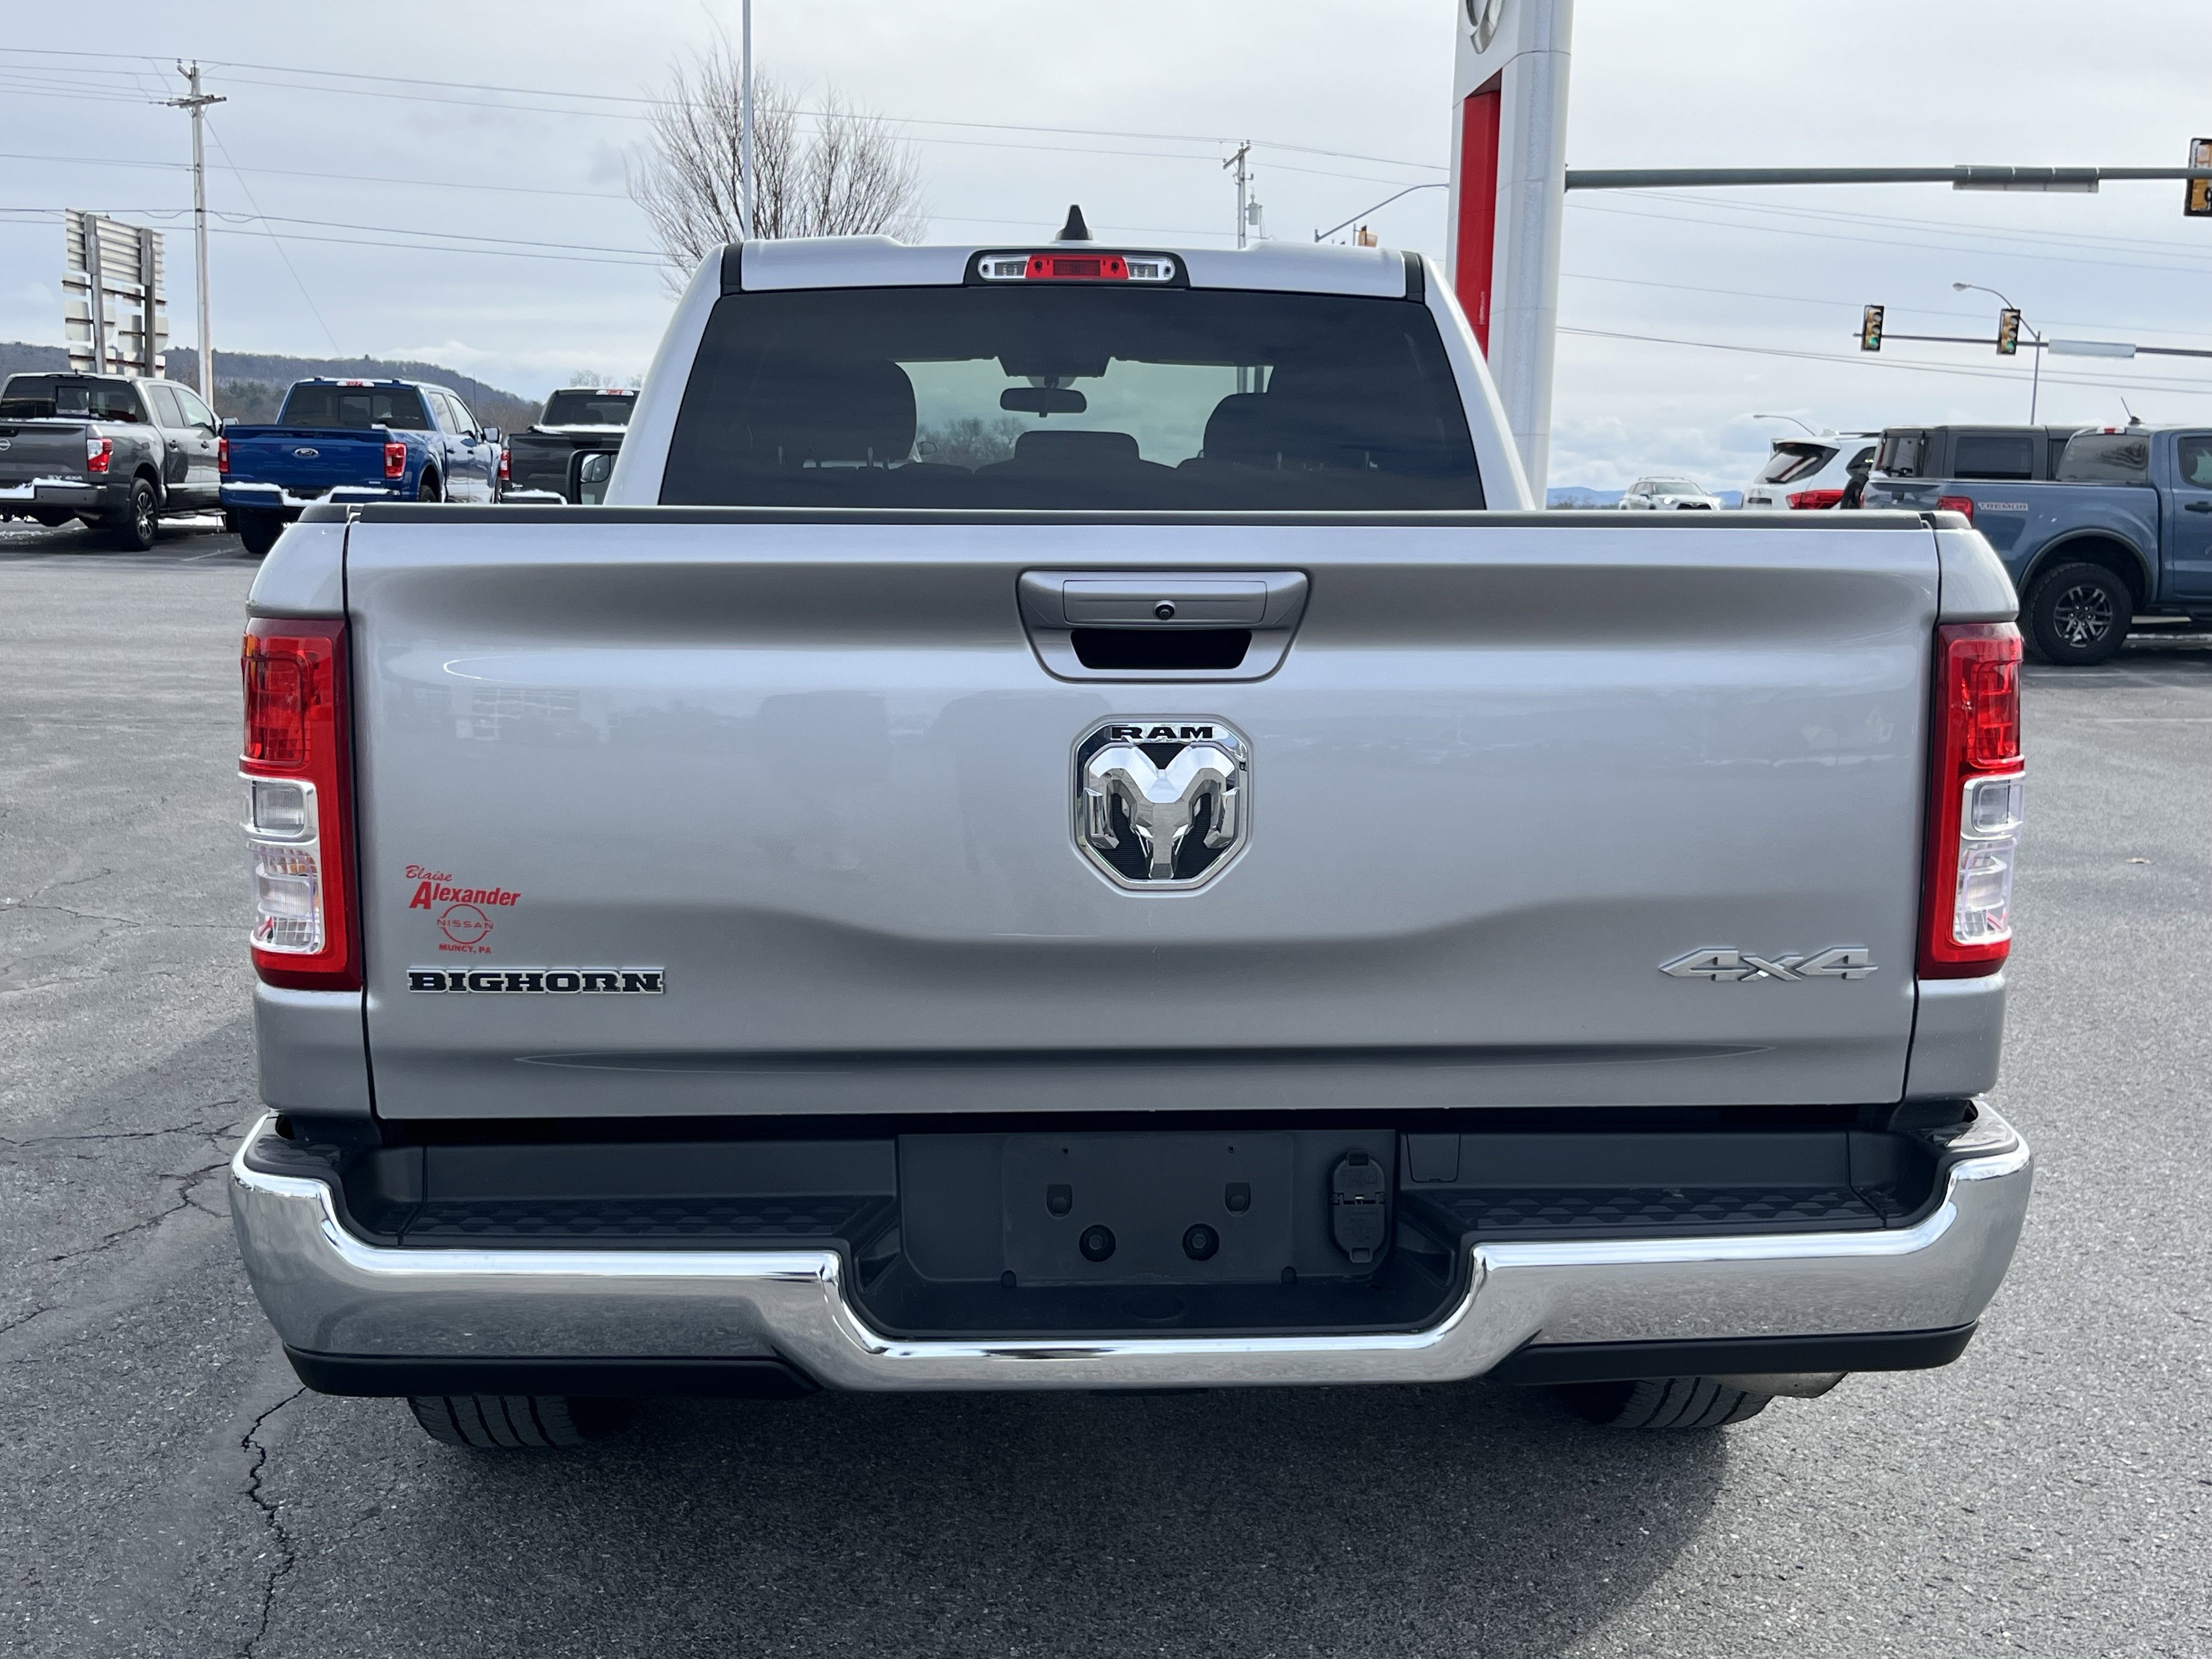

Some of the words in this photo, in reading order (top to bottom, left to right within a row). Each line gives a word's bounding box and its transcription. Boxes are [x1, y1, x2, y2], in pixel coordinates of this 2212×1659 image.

[1978, 502, 2028, 511] TREMOR
[1111, 726, 1214, 740] RAM
[406, 865, 452, 882] Blaise
[409, 881, 521, 910] Alexander
[437, 918, 493, 929] NISSAN
[439, 944, 476, 954] MUNCY,
[406, 967, 665, 994] BIGHORN
